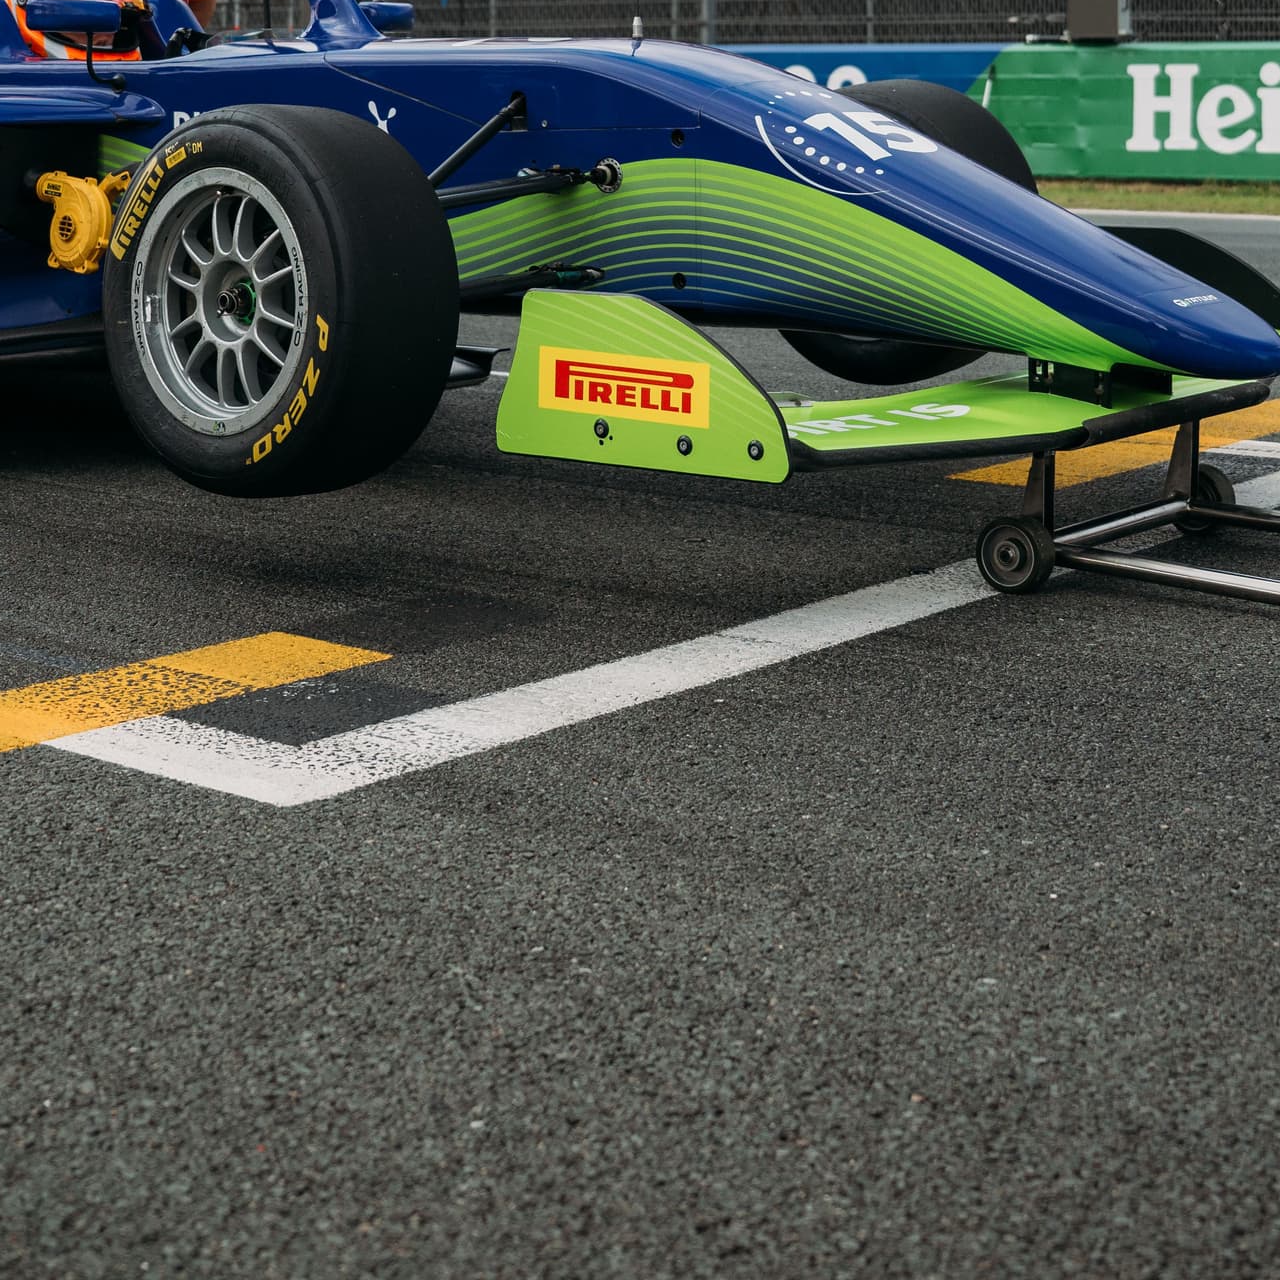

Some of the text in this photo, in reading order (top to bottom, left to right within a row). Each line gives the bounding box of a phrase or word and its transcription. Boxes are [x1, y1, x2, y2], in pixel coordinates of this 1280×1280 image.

[802, 110, 939, 161] 15
[110, 156, 165, 261] PIRELLI
[290, 245, 305, 307] RACING
[252, 313, 330, 464] P ZERO
[554, 359, 695, 414] PIRELLI
[886, 403, 971, 421] IS
